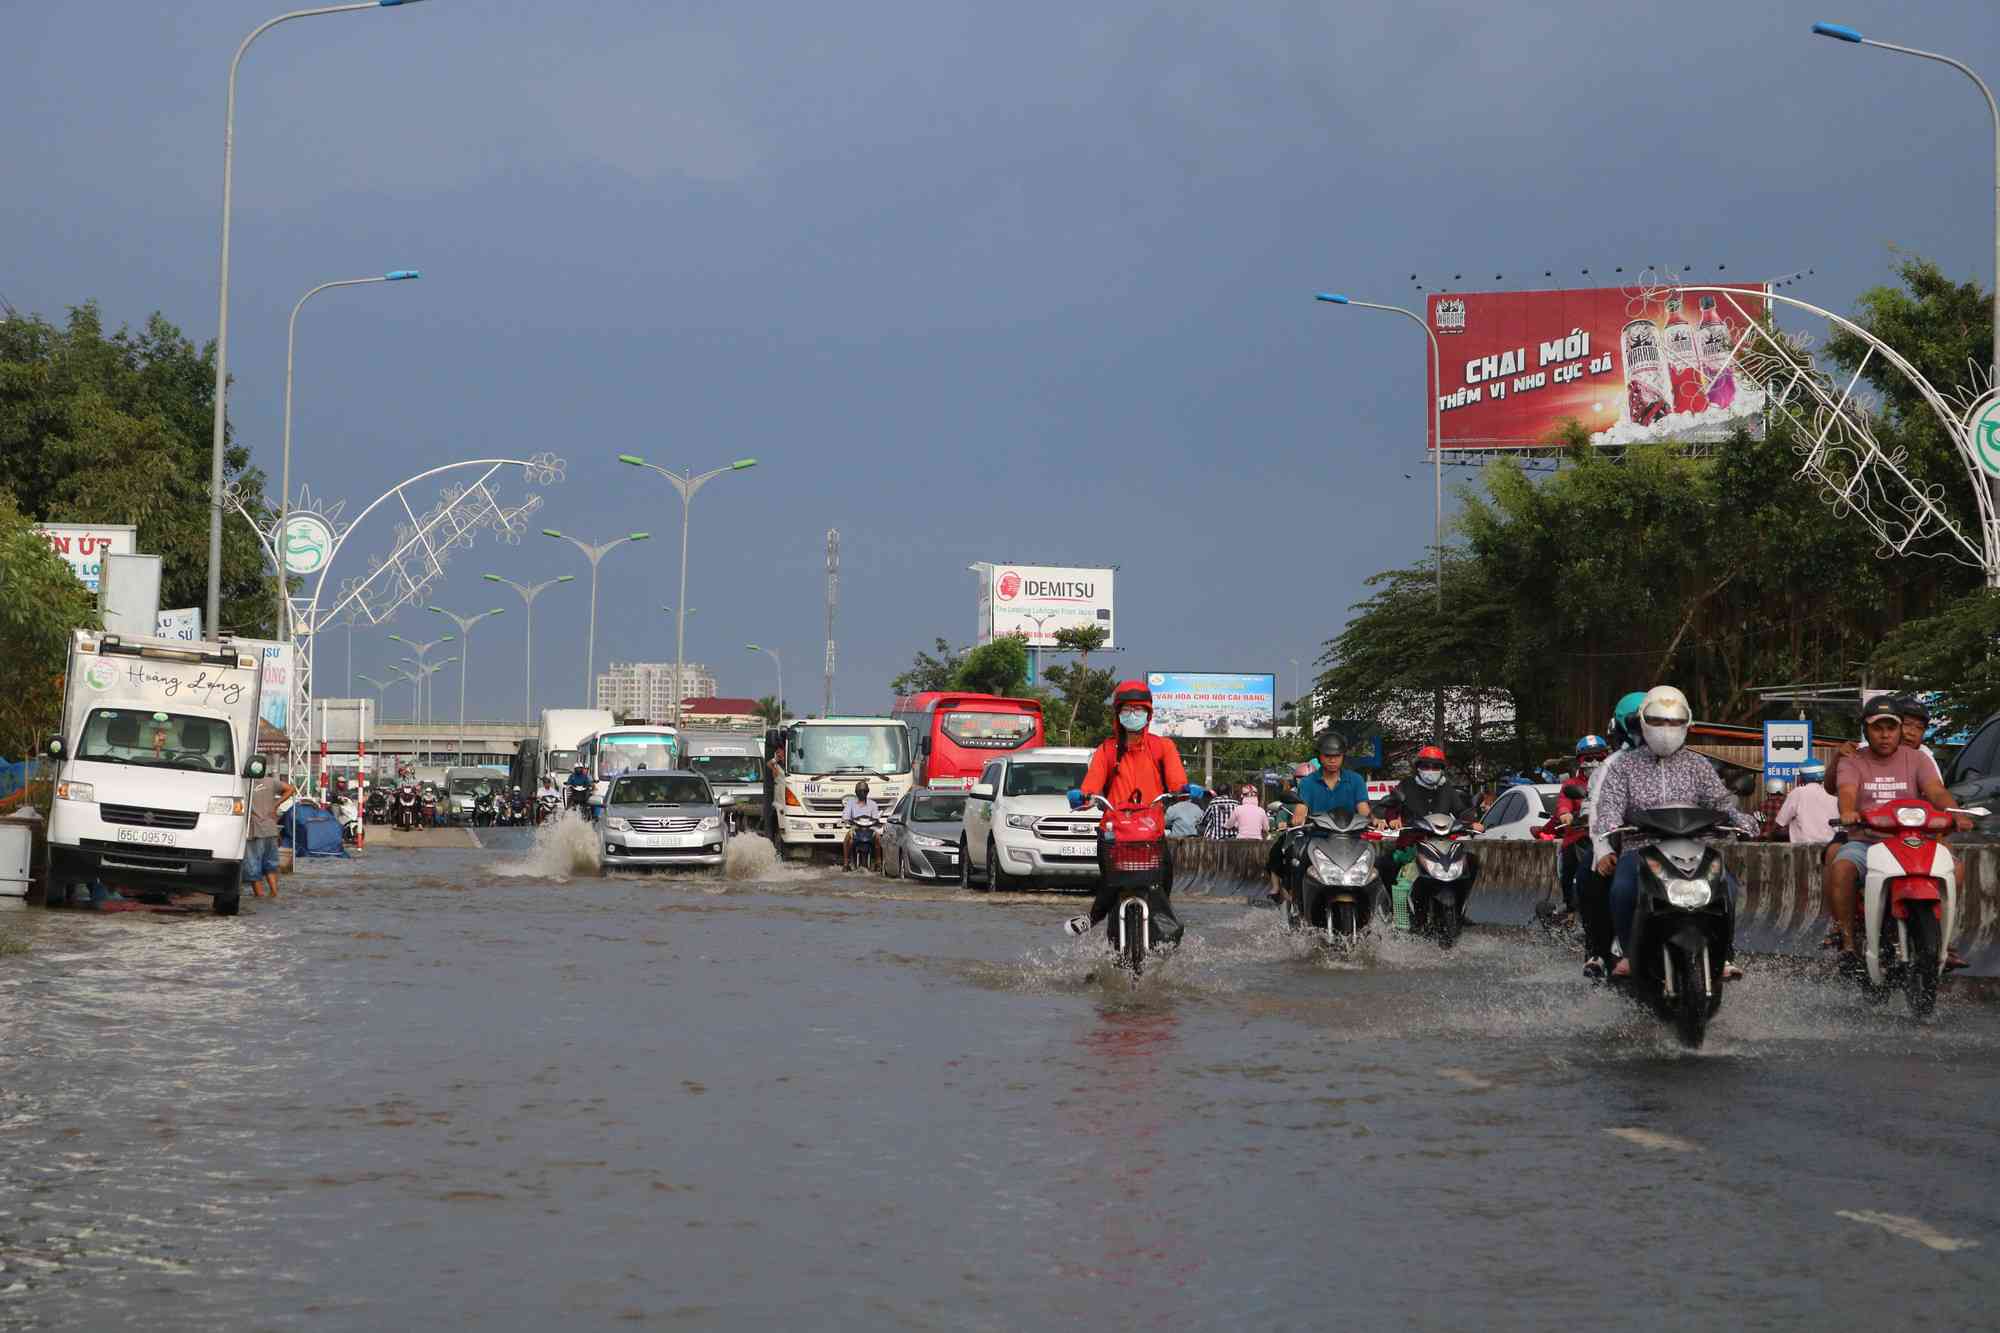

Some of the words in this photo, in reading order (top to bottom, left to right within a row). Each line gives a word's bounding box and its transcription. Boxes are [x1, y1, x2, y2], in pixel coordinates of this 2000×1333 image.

[1466, 348, 1525, 384] CHAI
[1539, 328, 1591, 367] MỚI
[1439, 387, 1482, 411] THÊM
[1490, 381, 1506, 400] VỊ
[1513, 372, 1546, 393] NHO
[1553, 362, 1584, 384] CỰC
[1589, 352, 1612, 374] ĐÃ
[82, 563, 101, 576] LO
[1024, 580, 1094, 599] IDEMITSU
[187, 672, 246, 704] Long
[804, 783, 822, 793] HUY
